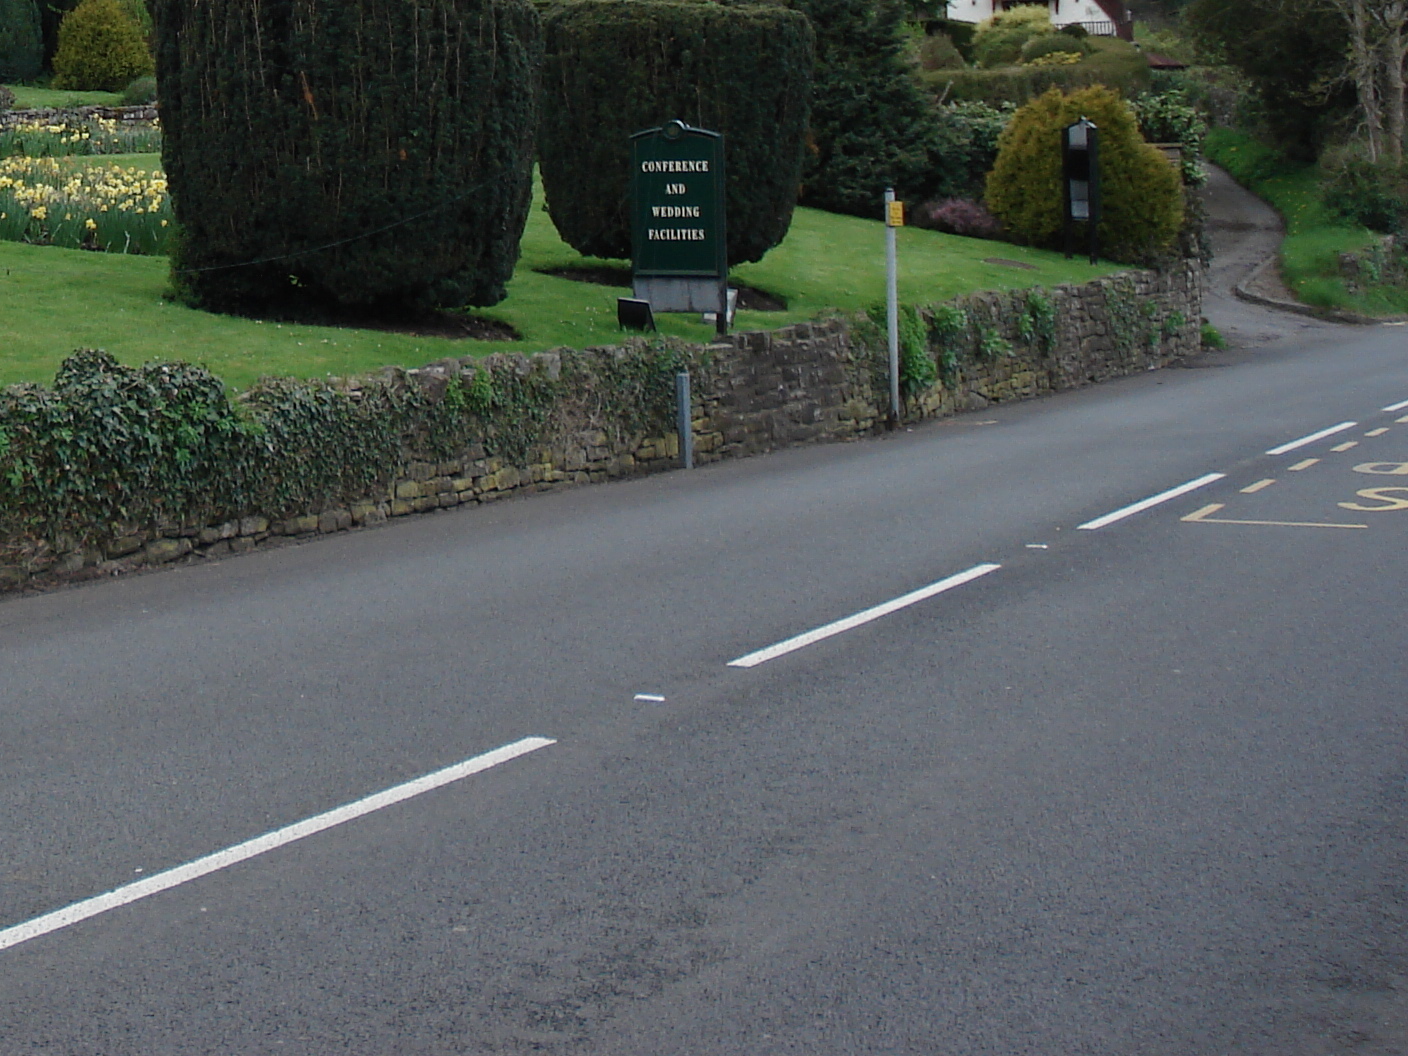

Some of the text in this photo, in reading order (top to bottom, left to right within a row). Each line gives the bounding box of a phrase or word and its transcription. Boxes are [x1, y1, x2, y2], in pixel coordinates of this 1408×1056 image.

[642, 161, 709, 172] CONFERENCE
[665, 184, 686, 195] AND
[652, 206, 700, 218] WEDDING
[648, 229, 705, 240] FACILITIES
